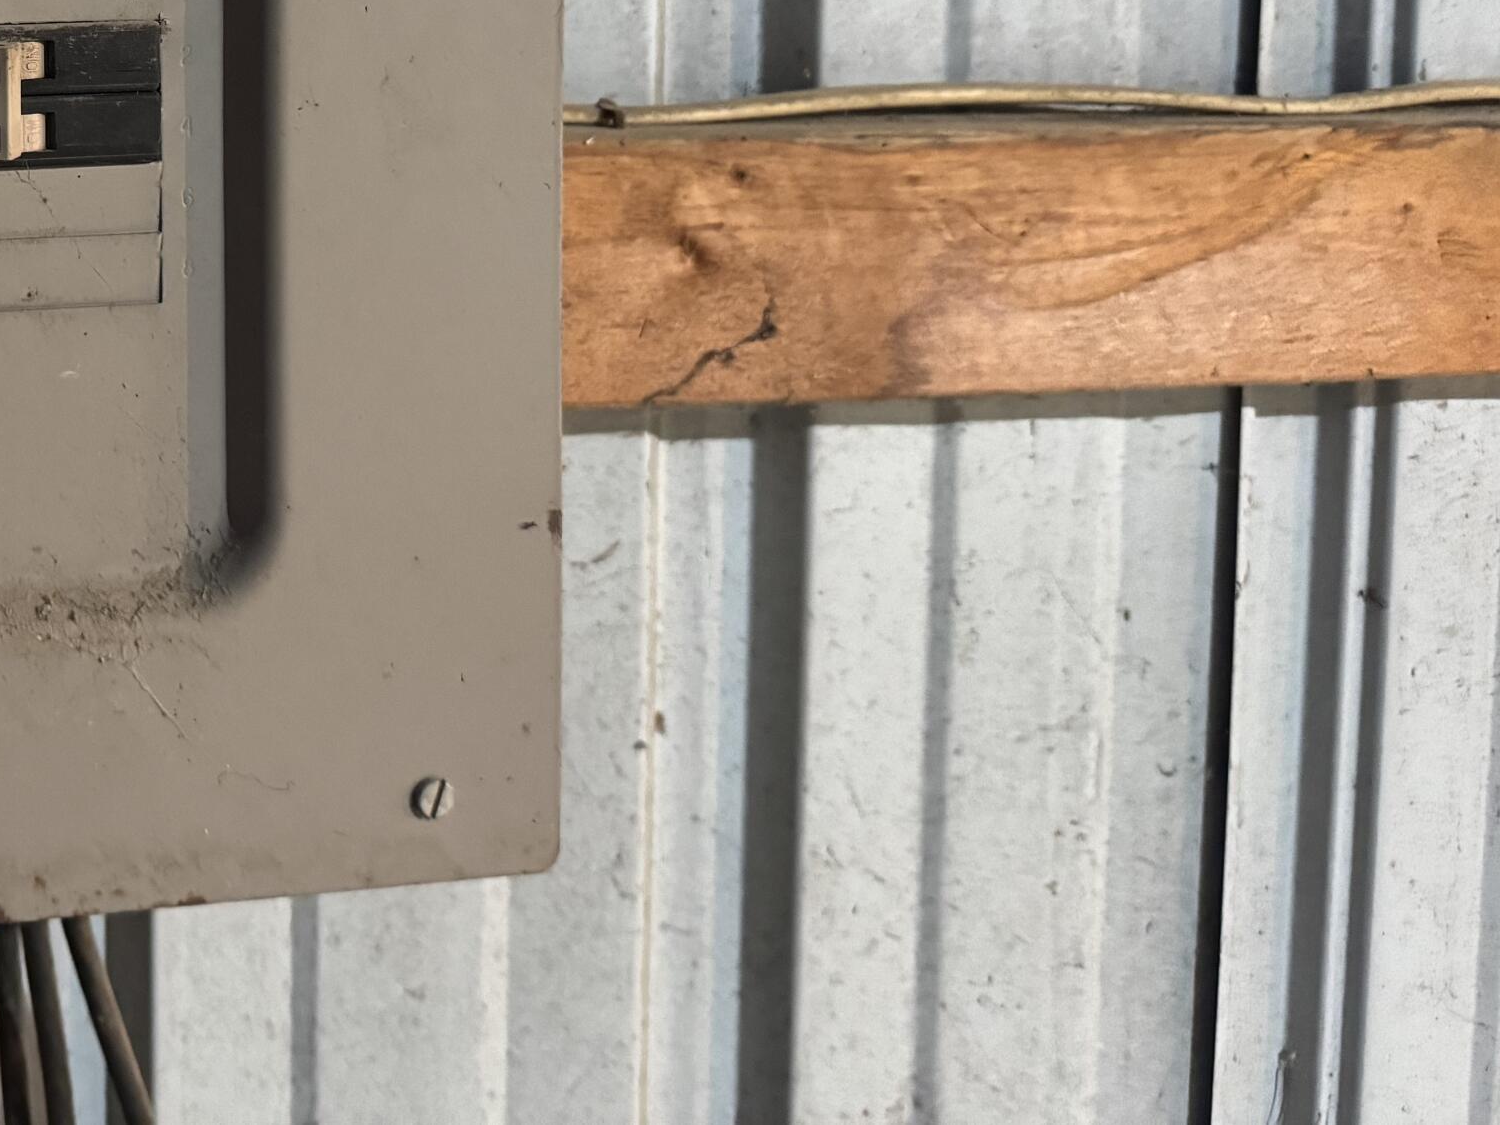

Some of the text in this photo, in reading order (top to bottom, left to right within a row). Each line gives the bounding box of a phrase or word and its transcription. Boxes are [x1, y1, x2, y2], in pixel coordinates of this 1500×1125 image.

[180, 43, 193, 68] 2
[179, 115, 192, 138] 4
[181, 187, 195, 211] 6
[181, 259, 195, 281] 8
